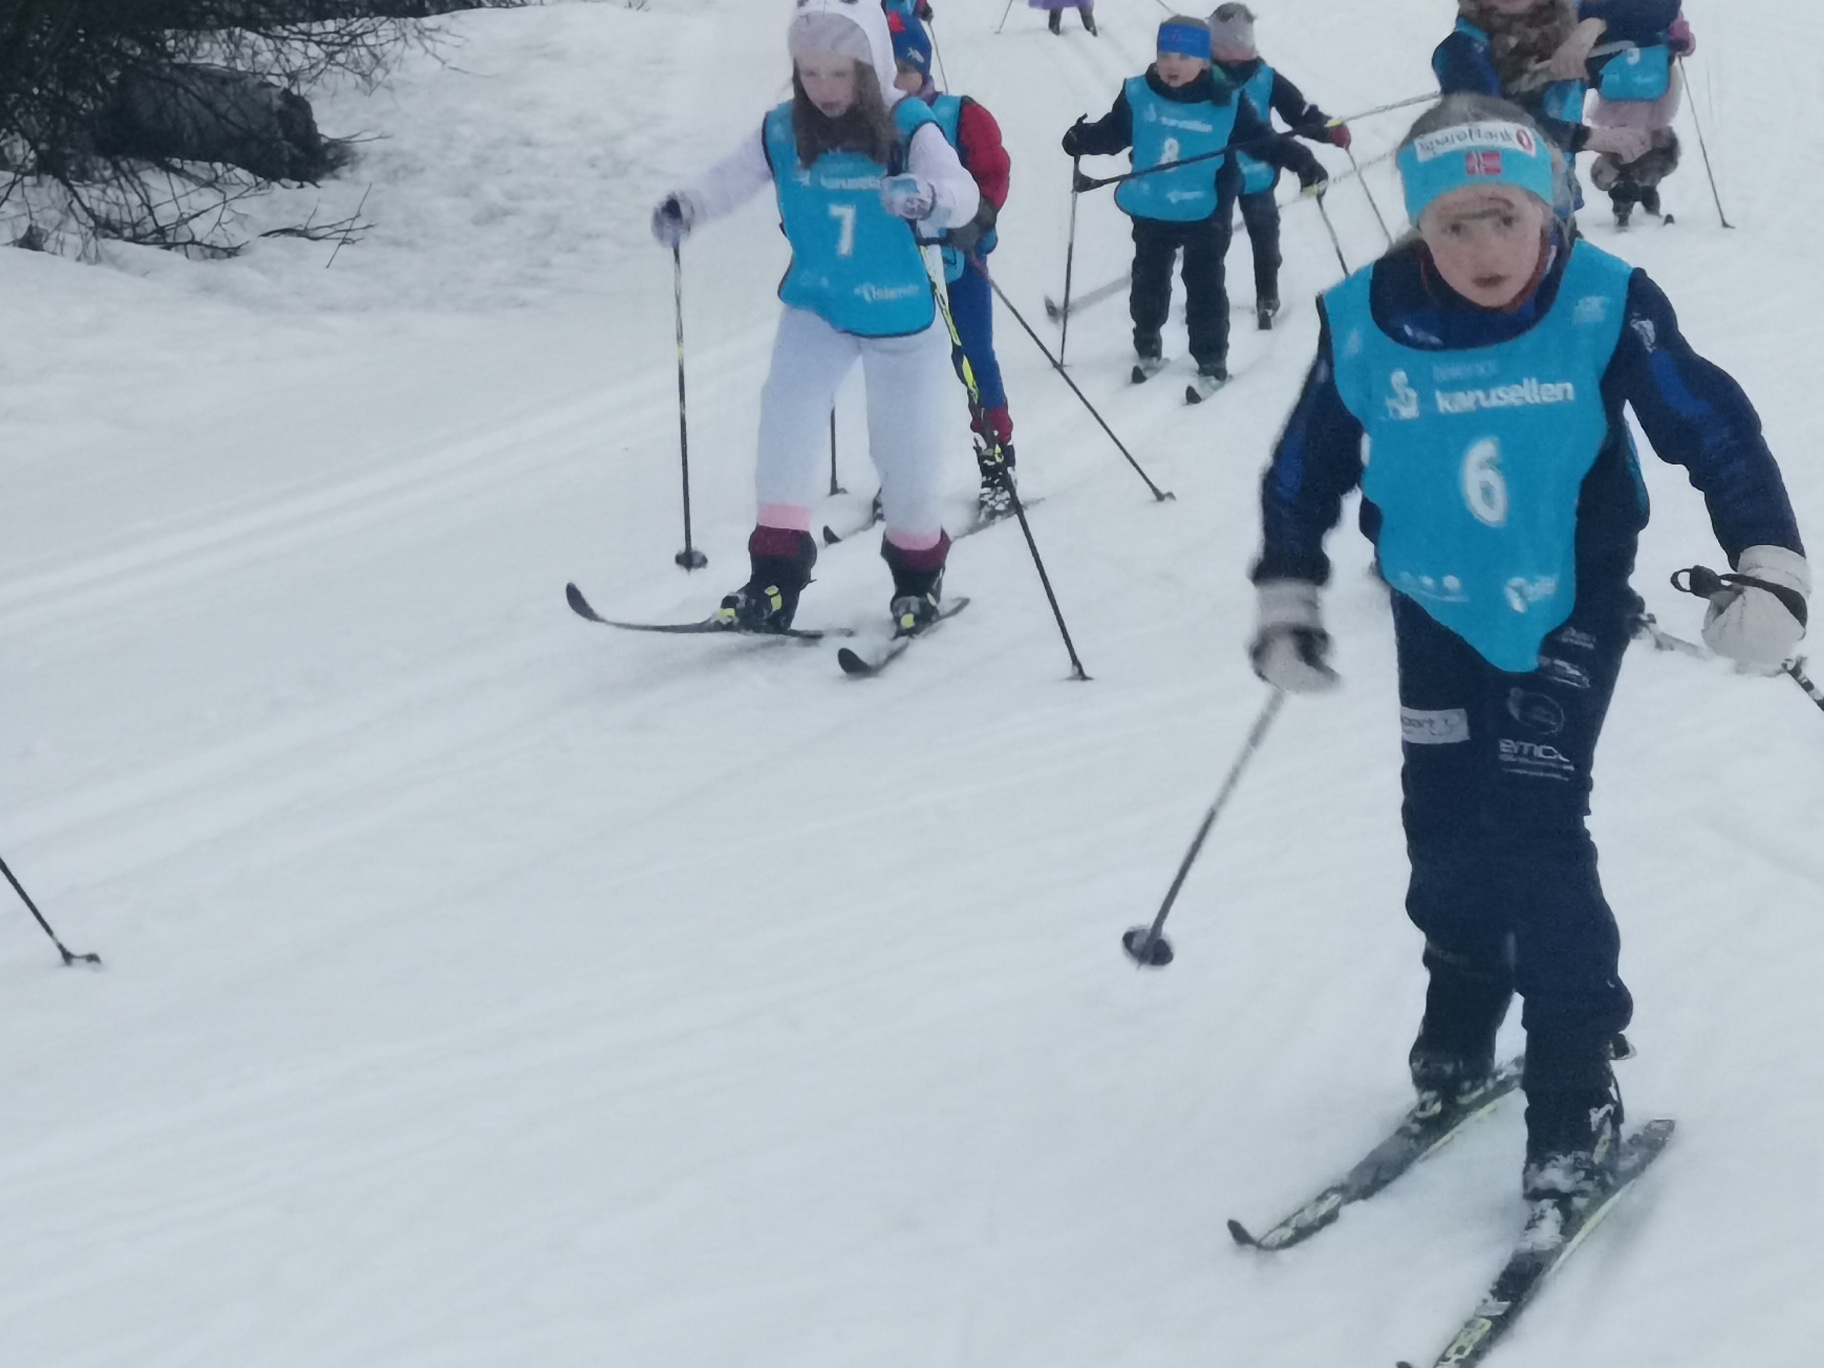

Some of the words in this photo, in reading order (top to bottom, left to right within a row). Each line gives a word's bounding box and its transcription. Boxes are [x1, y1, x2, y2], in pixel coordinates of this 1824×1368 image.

[828, 203, 856, 257] 7
[1434, 377, 1575, 414] karusellen
[1461, 435, 1508, 527] 6
